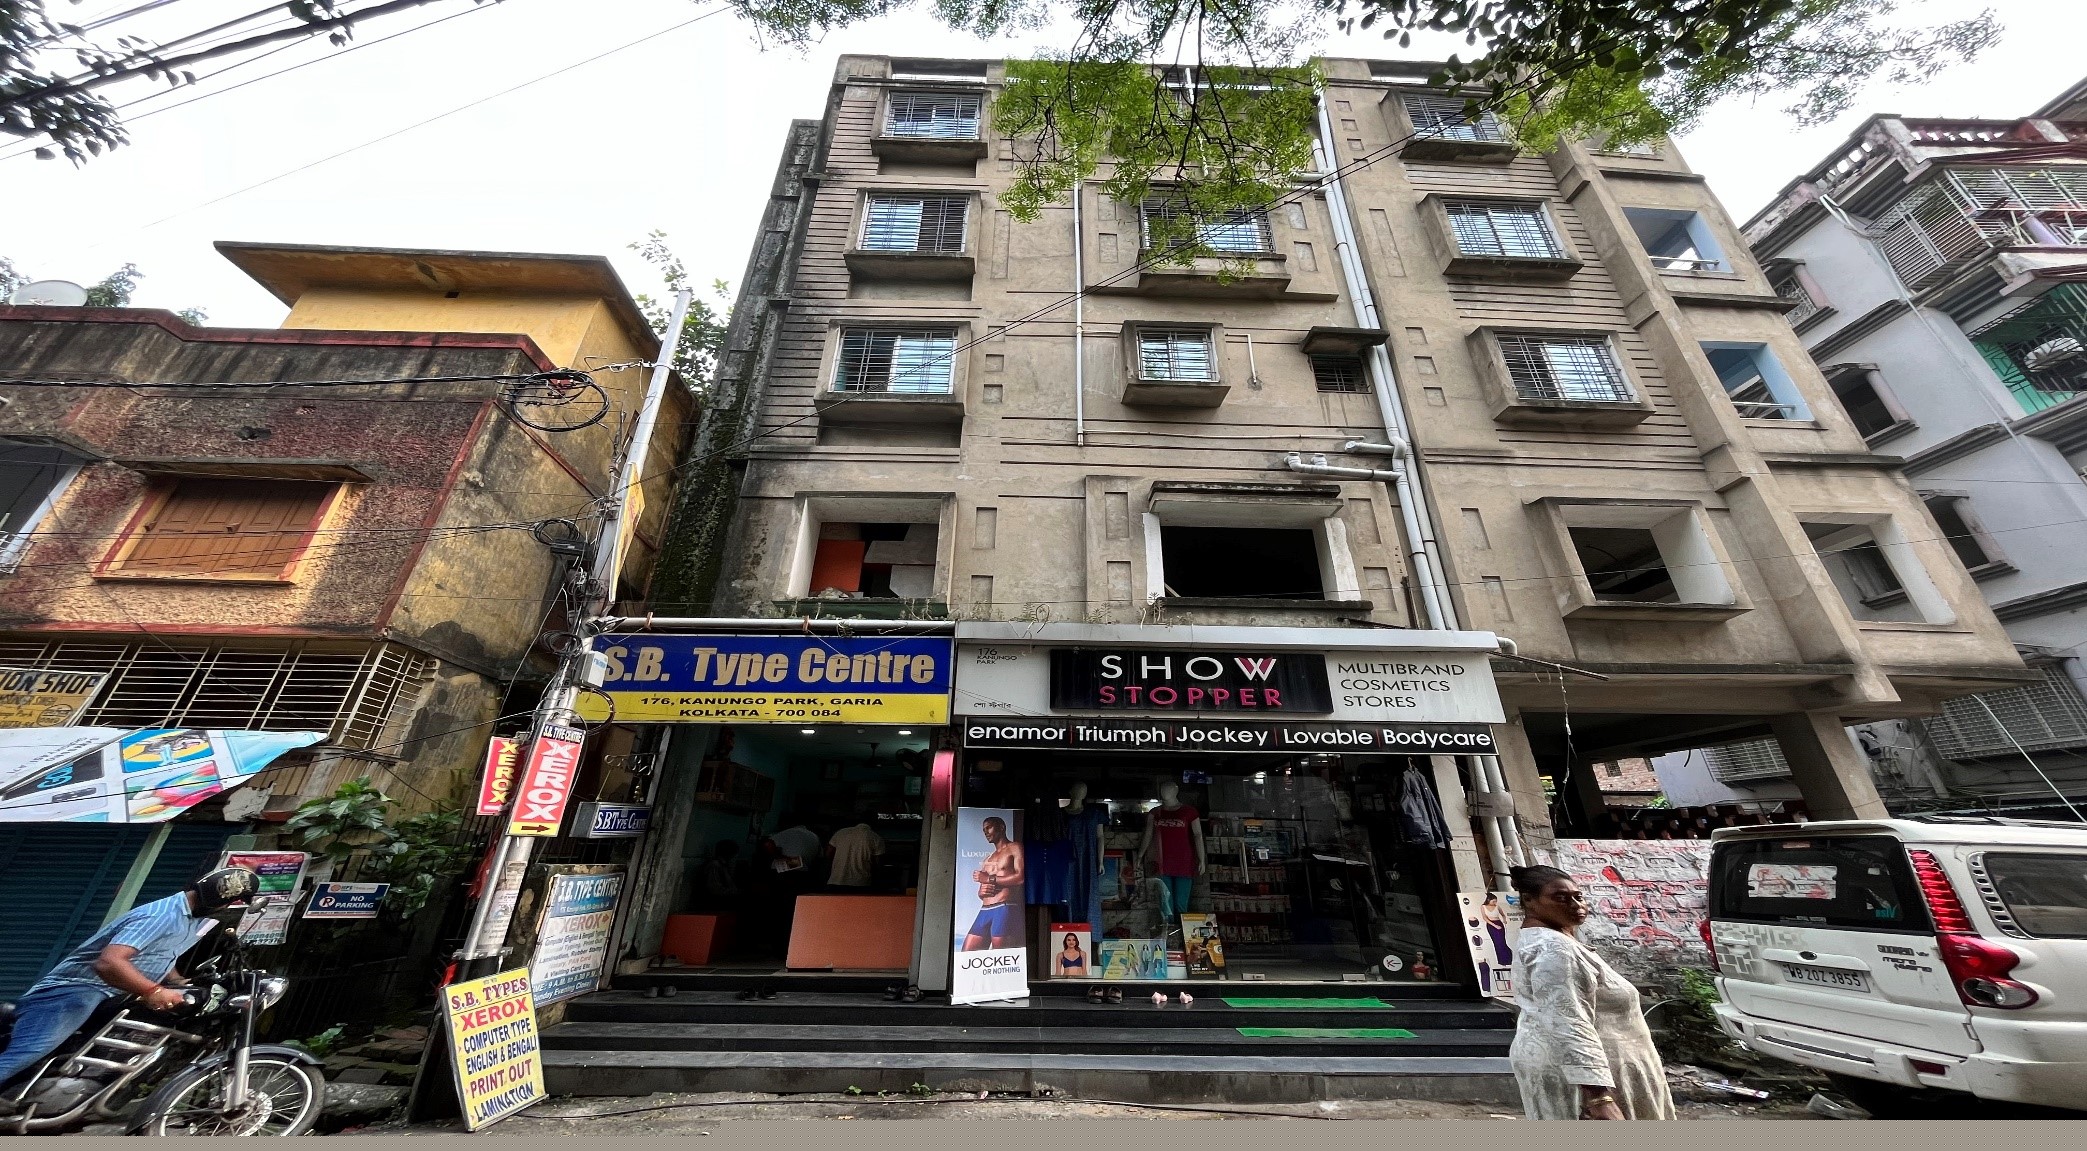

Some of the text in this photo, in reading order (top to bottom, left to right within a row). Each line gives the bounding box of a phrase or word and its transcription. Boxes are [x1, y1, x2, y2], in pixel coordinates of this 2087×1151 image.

[978, 647, 998, 656] 176
[605, 646, 935, 686] S.B. Type Centre
[1101, 655, 1277, 681] SHOW
[1338, 662, 1465, 676] MULTIBRAND
[37, 673, 100, 695] SHOP
[1340, 679, 1450, 692] COSMETICS
[641, 697, 884, 707] 176, KANUNGO PARK, GARIA
[1099, 686, 1283, 707] STOPPER
[1343, 695, 1417, 708] STORES
[679, 709, 760, 717] KOLKATA
[776, 709, 805, 717] 700
[811, 709, 841, 717] 084
[968, 725, 1491, 749] enamor Triumph Jockey Lovable Bodycare
[488, 741, 520, 803] XEROX
[520, 740, 577, 821] XEROX
[574, 880, 595, 902] TYPE
[560, 913, 602, 933] XEROX
[961, 954, 1020, 970] JOCKEY
[982, 966, 1021, 976] OR NOTHING
[1830, 971, 1861, 987] 3855
[452, 977, 527, 1010] S.B. TYPES
[460, 996, 529, 1031] XEROX
[463, 1017, 532, 1055] COMPUTER TYPE
[465, 1034, 538, 1076] ENGLISH & BENGALI
[470, 1058, 532, 1099] PRINT OUT
[474, 1081, 535, 1123] LAMINATION
